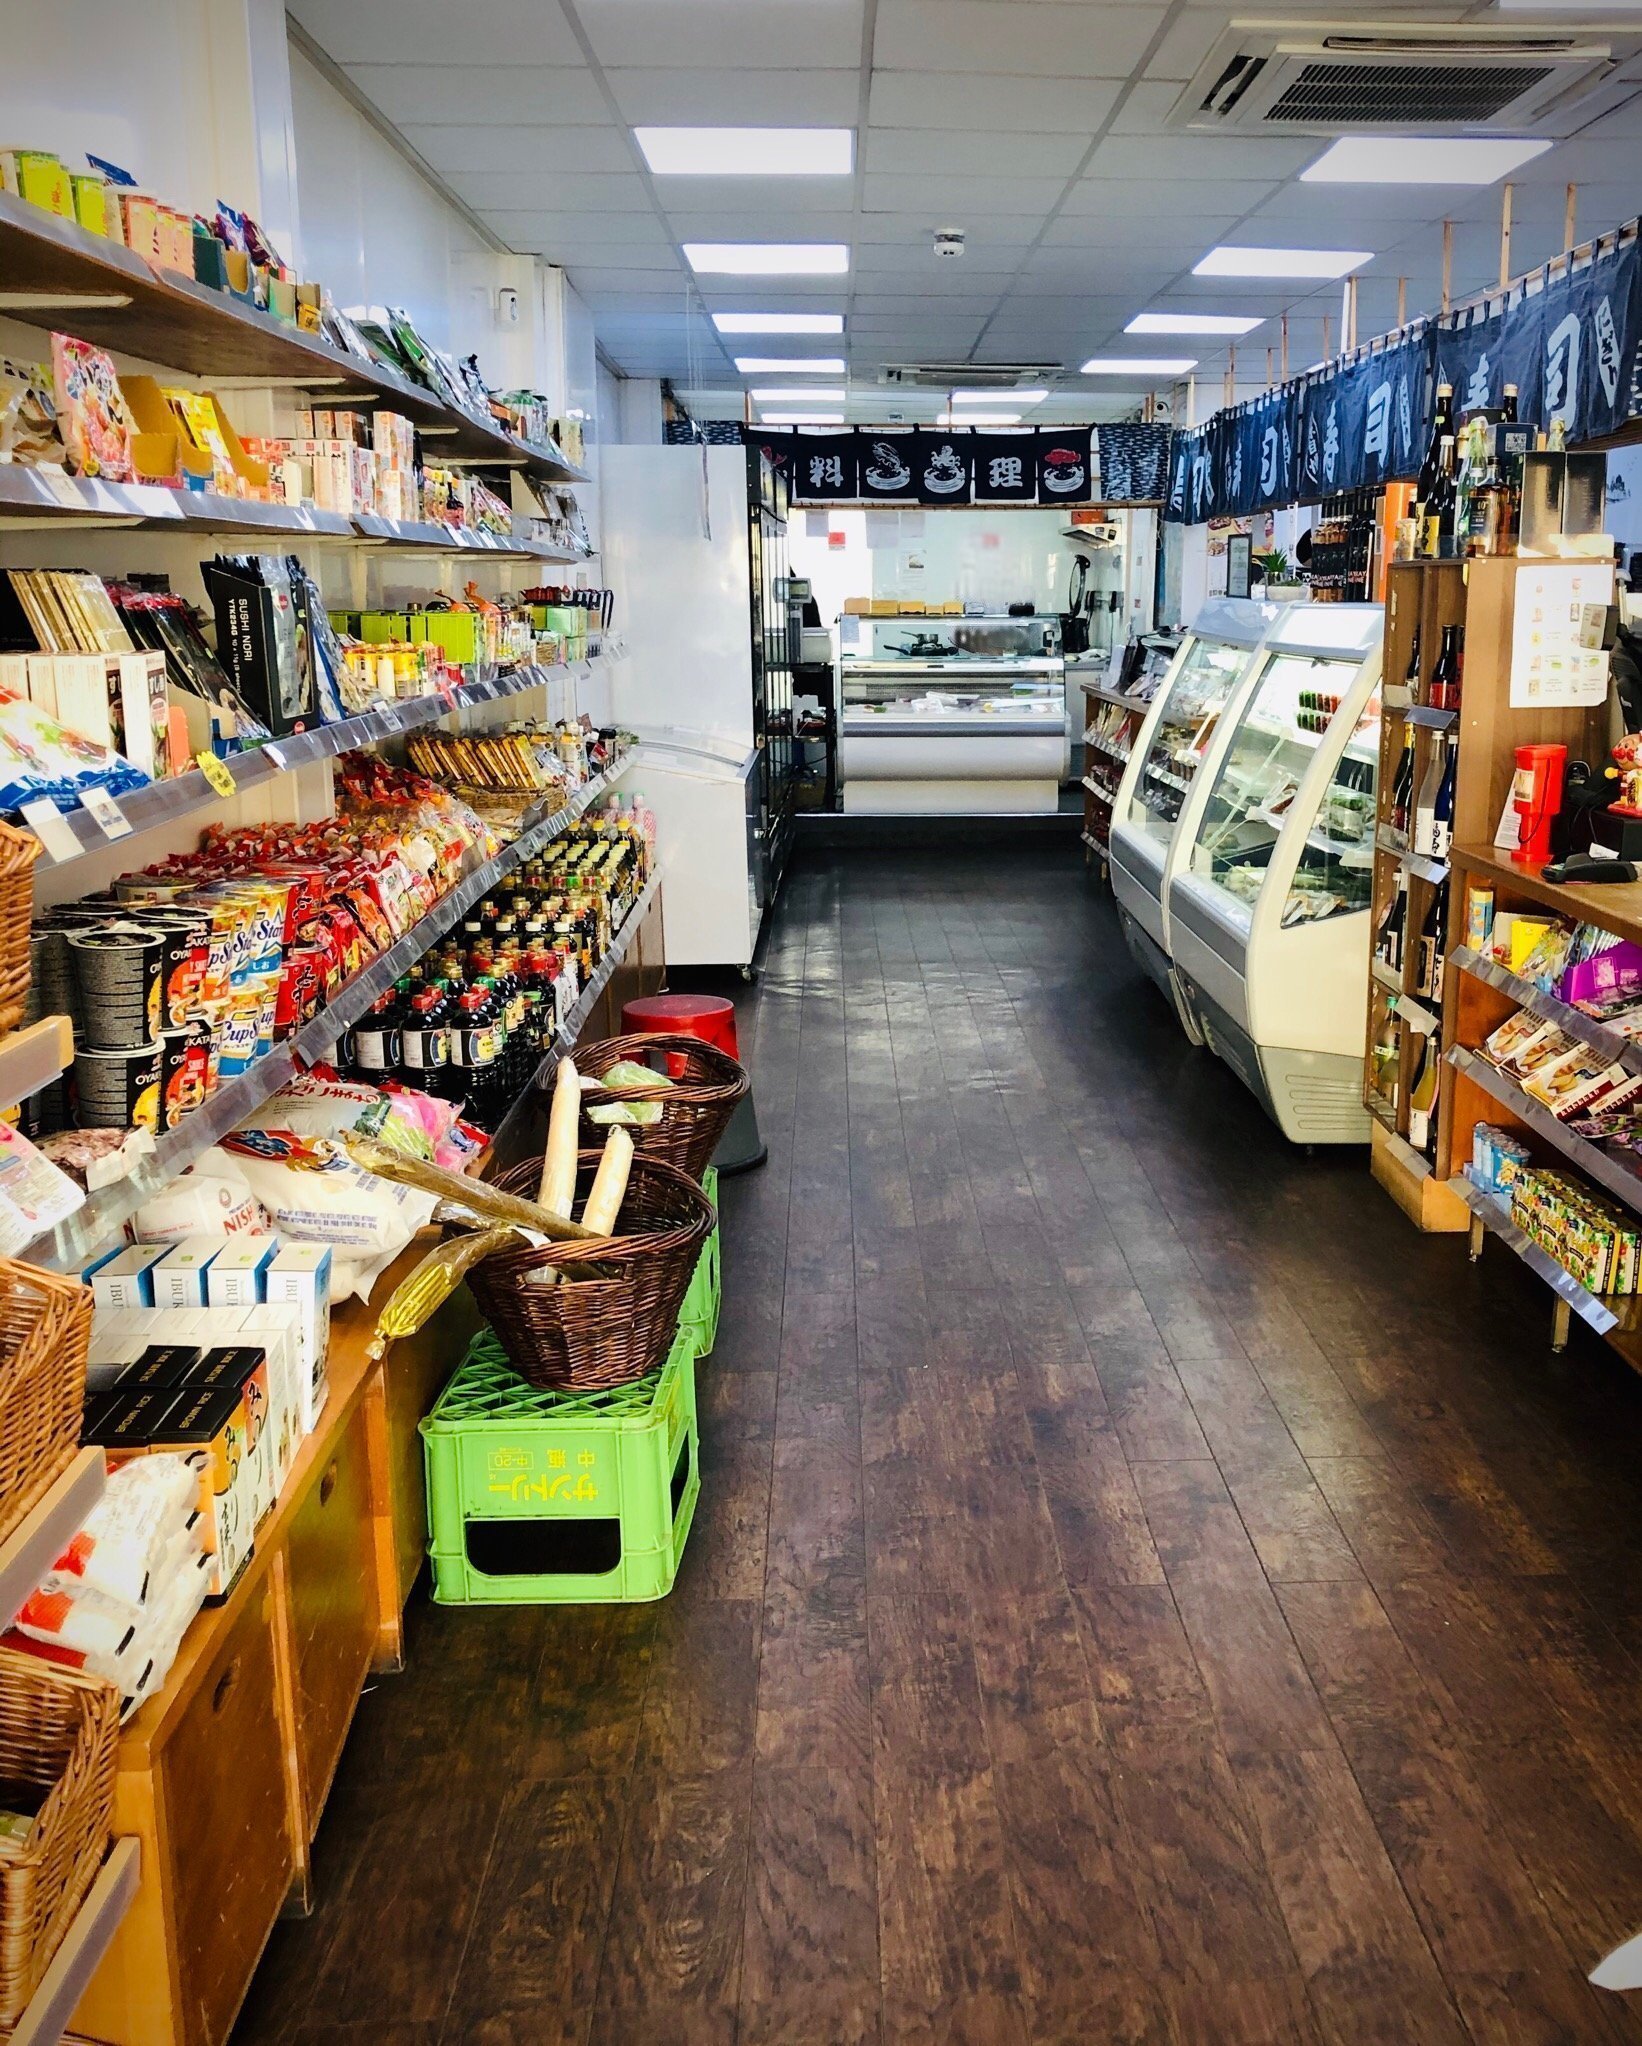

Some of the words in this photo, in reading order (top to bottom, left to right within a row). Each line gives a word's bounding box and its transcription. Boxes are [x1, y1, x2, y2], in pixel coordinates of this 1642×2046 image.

[810, 455, 843, 487] 料
[988, 456, 1023, 488] 理
[238, 598, 250, 631] SUSHI
[242, 635, 253, 661] NORI
[252, 961, 270, 971] しお
[115, 1409, 140, 1433] BROWN
[136, 1394, 155, 1408] RICE
[179, 1406, 202, 1429] BROWN
[488, 1472, 599, 1501] サントリー
